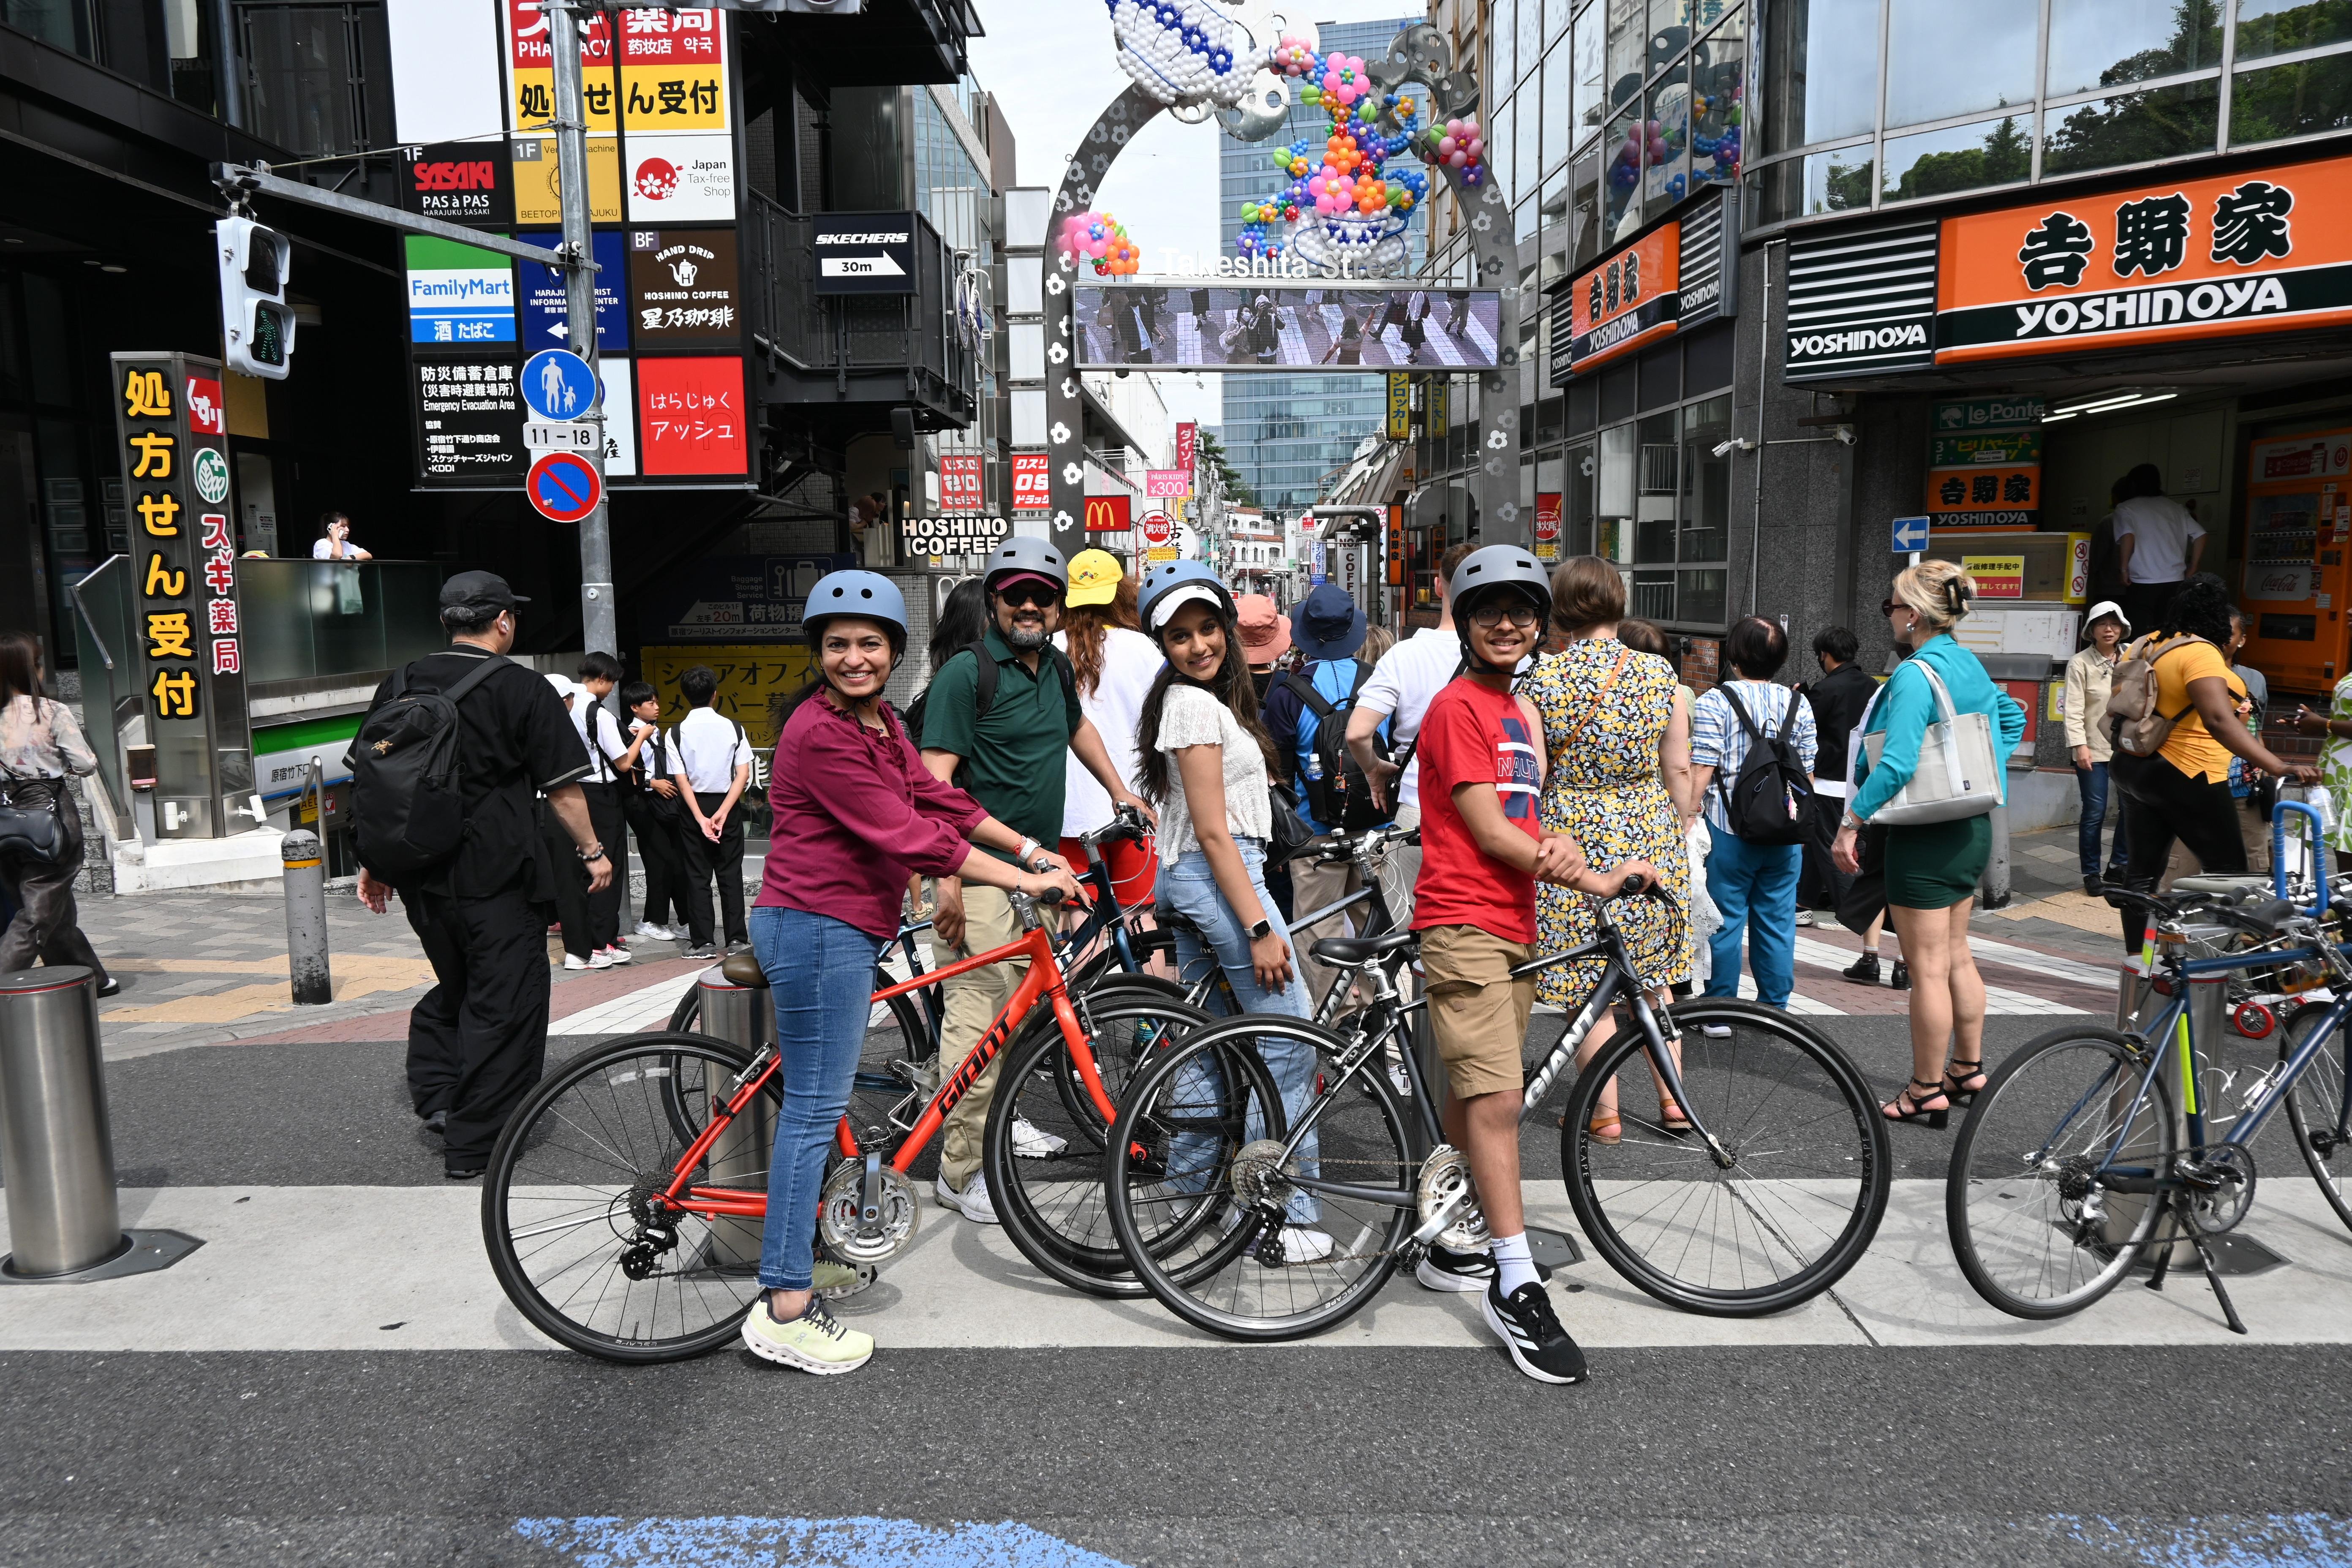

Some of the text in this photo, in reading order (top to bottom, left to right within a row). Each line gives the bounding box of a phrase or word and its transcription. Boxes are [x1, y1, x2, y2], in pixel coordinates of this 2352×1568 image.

[519, 39, 611, 57] PHAACY
[627, 37, 713, 55] 药妆店 약국
[520, 79, 719, 118] 処せん受付
[404, 147, 423, 161] 1F
[516, 143, 536, 158] 1F
[692, 160, 727, 171] Japan
[687, 173, 730, 183] Tax-free
[423, 194, 489, 208] PAS à PAS
[704, 187, 731, 198] Shop
[521, 209, 618, 218] BEETOPI AJUKU
[635, 232, 654, 248] BF
[816, 232, 909, 244] SKECHERS
[655, 245, 715, 262] HAND DRIP
[841, 261, 872, 272] 30m
[1158, 248, 1414, 280] Takeshita Street
[412, 279, 510, 299] FamilyMart
[645, 291, 729, 300] HOSHINO COFFEE
[1680, 279, 1720, 312] YOSHINOYA
[2016, 277, 2288, 338] YOSHINOYA
[641, 305, 734, 330] 星乃珈琲
[433, 321, 494, 340] 酒 たばこ
[1590, 311, 1639, 353] YOSHINOYA
[1791, 324, 1926, 357] YOSHINOYA
[1552, 351, 1572, 371] YOSHINO
[421, 365, 513, 381] 防災備蓄倉庫
[187, 378, 223, 433] くすり
[424, 399, 515, 413] Emergency Evacuation Area
[651, 392, 730, 410] はらじゅく
[1392, 374, 1407, 429] ンロッカー
[1990, 401, 2045, 420] Ponte
[425, 420, 441, 430] 協賛
[651, 421, 735, 441] アッシュ
[1180, 429, 1192, 468] ダイソー
[1016, 458, 1048, 470] クスリ
[1015, 474, 1048, 491] OS
[1150, 482, 1184, 495] ¥300
[902, 518, 1007, 537] HOSHINO
[1938, 512, 2028, 525] YOSHINOYA
[1146, 523, 1168, 535] 消火栓
[125, 370, 198, 719] 処方せん受付
[911, 536, 999, 555] COFFEE
[201, 514, 241, 675] スギ薬局
[713, 611, 740, 622] 20m
[662, 662, 812, 686] シアオフィ
[271, 763, 310, 782] 原宿竹下口
[937, 1007, 1010, 1119] GIANT
[1176, 1044, 1208, 1067] ESCAPE
[1525, 1002, 1595, 1109] GIANT
[1580, 1130, 1590, 1178] ESCAPE
[1862, 1136, 1873, 1185] ESCAPE
[1325, 1283, 1358, 1309] ESCAPE
